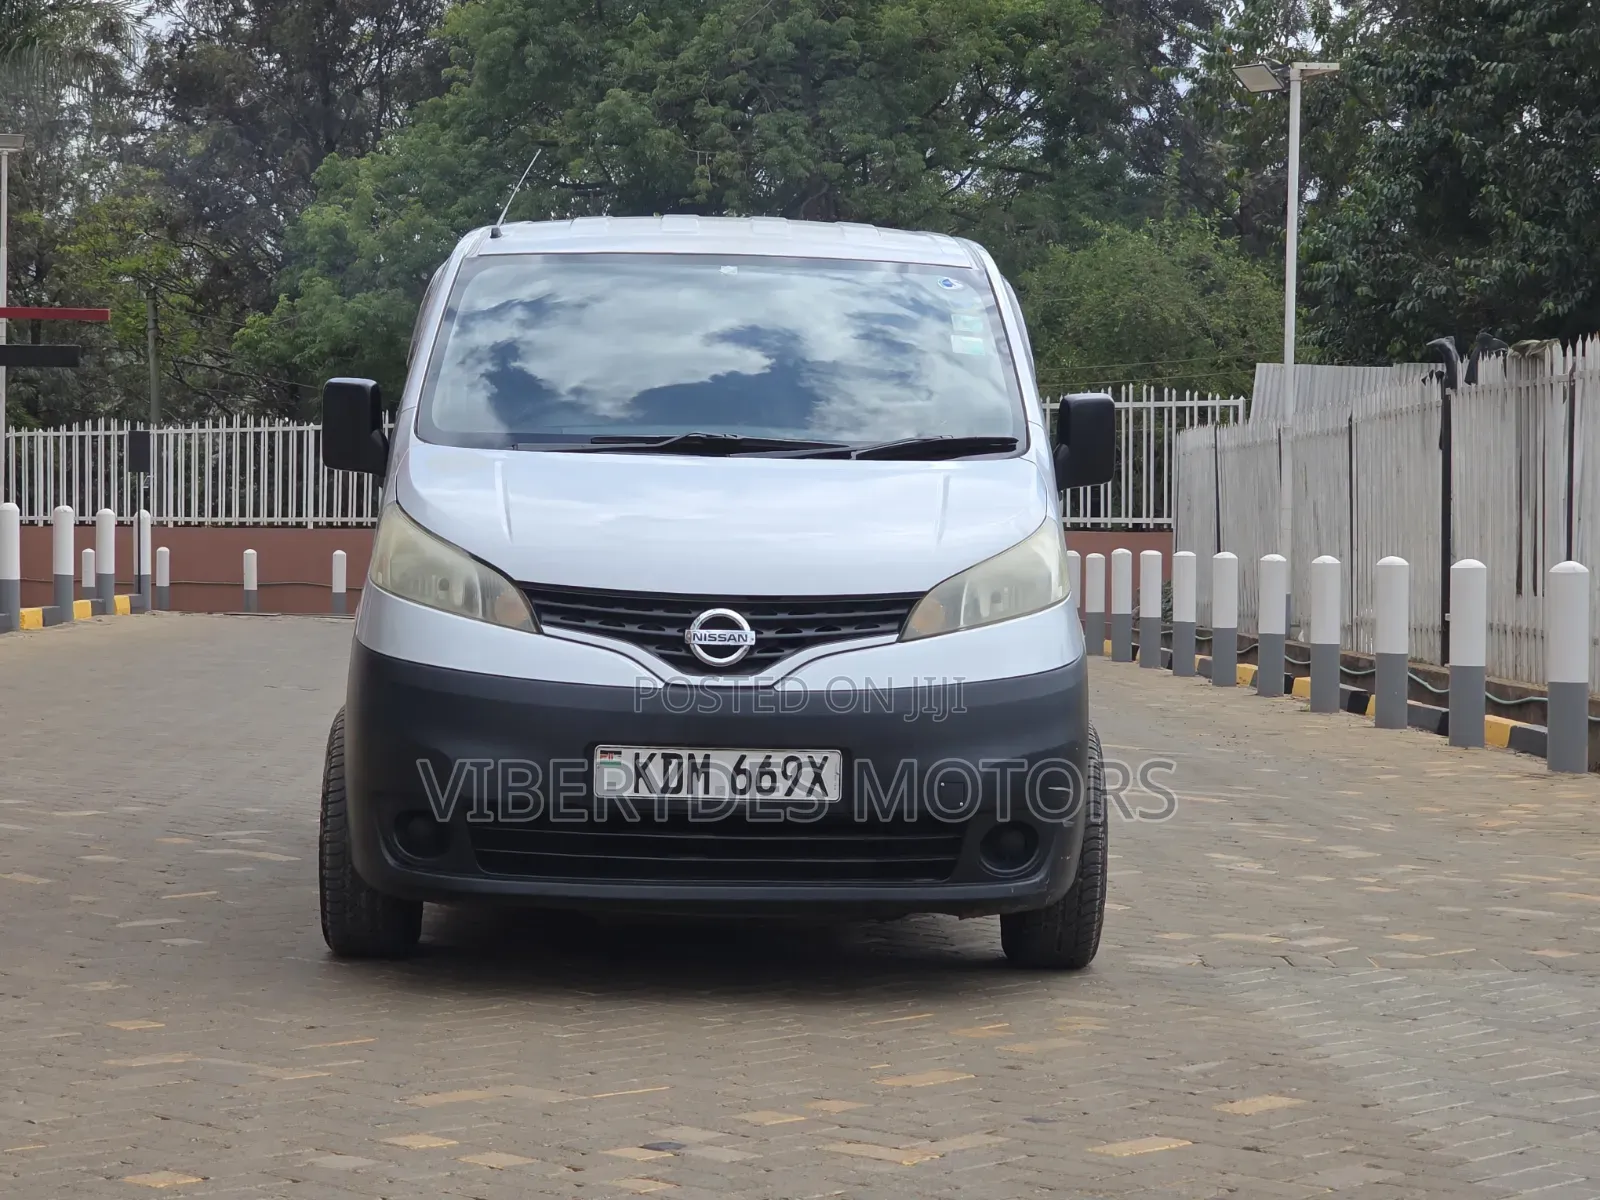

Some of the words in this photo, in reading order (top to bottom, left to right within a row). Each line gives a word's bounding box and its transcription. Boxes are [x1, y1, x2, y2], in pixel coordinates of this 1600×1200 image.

[692, 632, 748, 643] NISSAN
[633, 752, 711, 796] KDM
[730, 754, 829, 797] 669X
